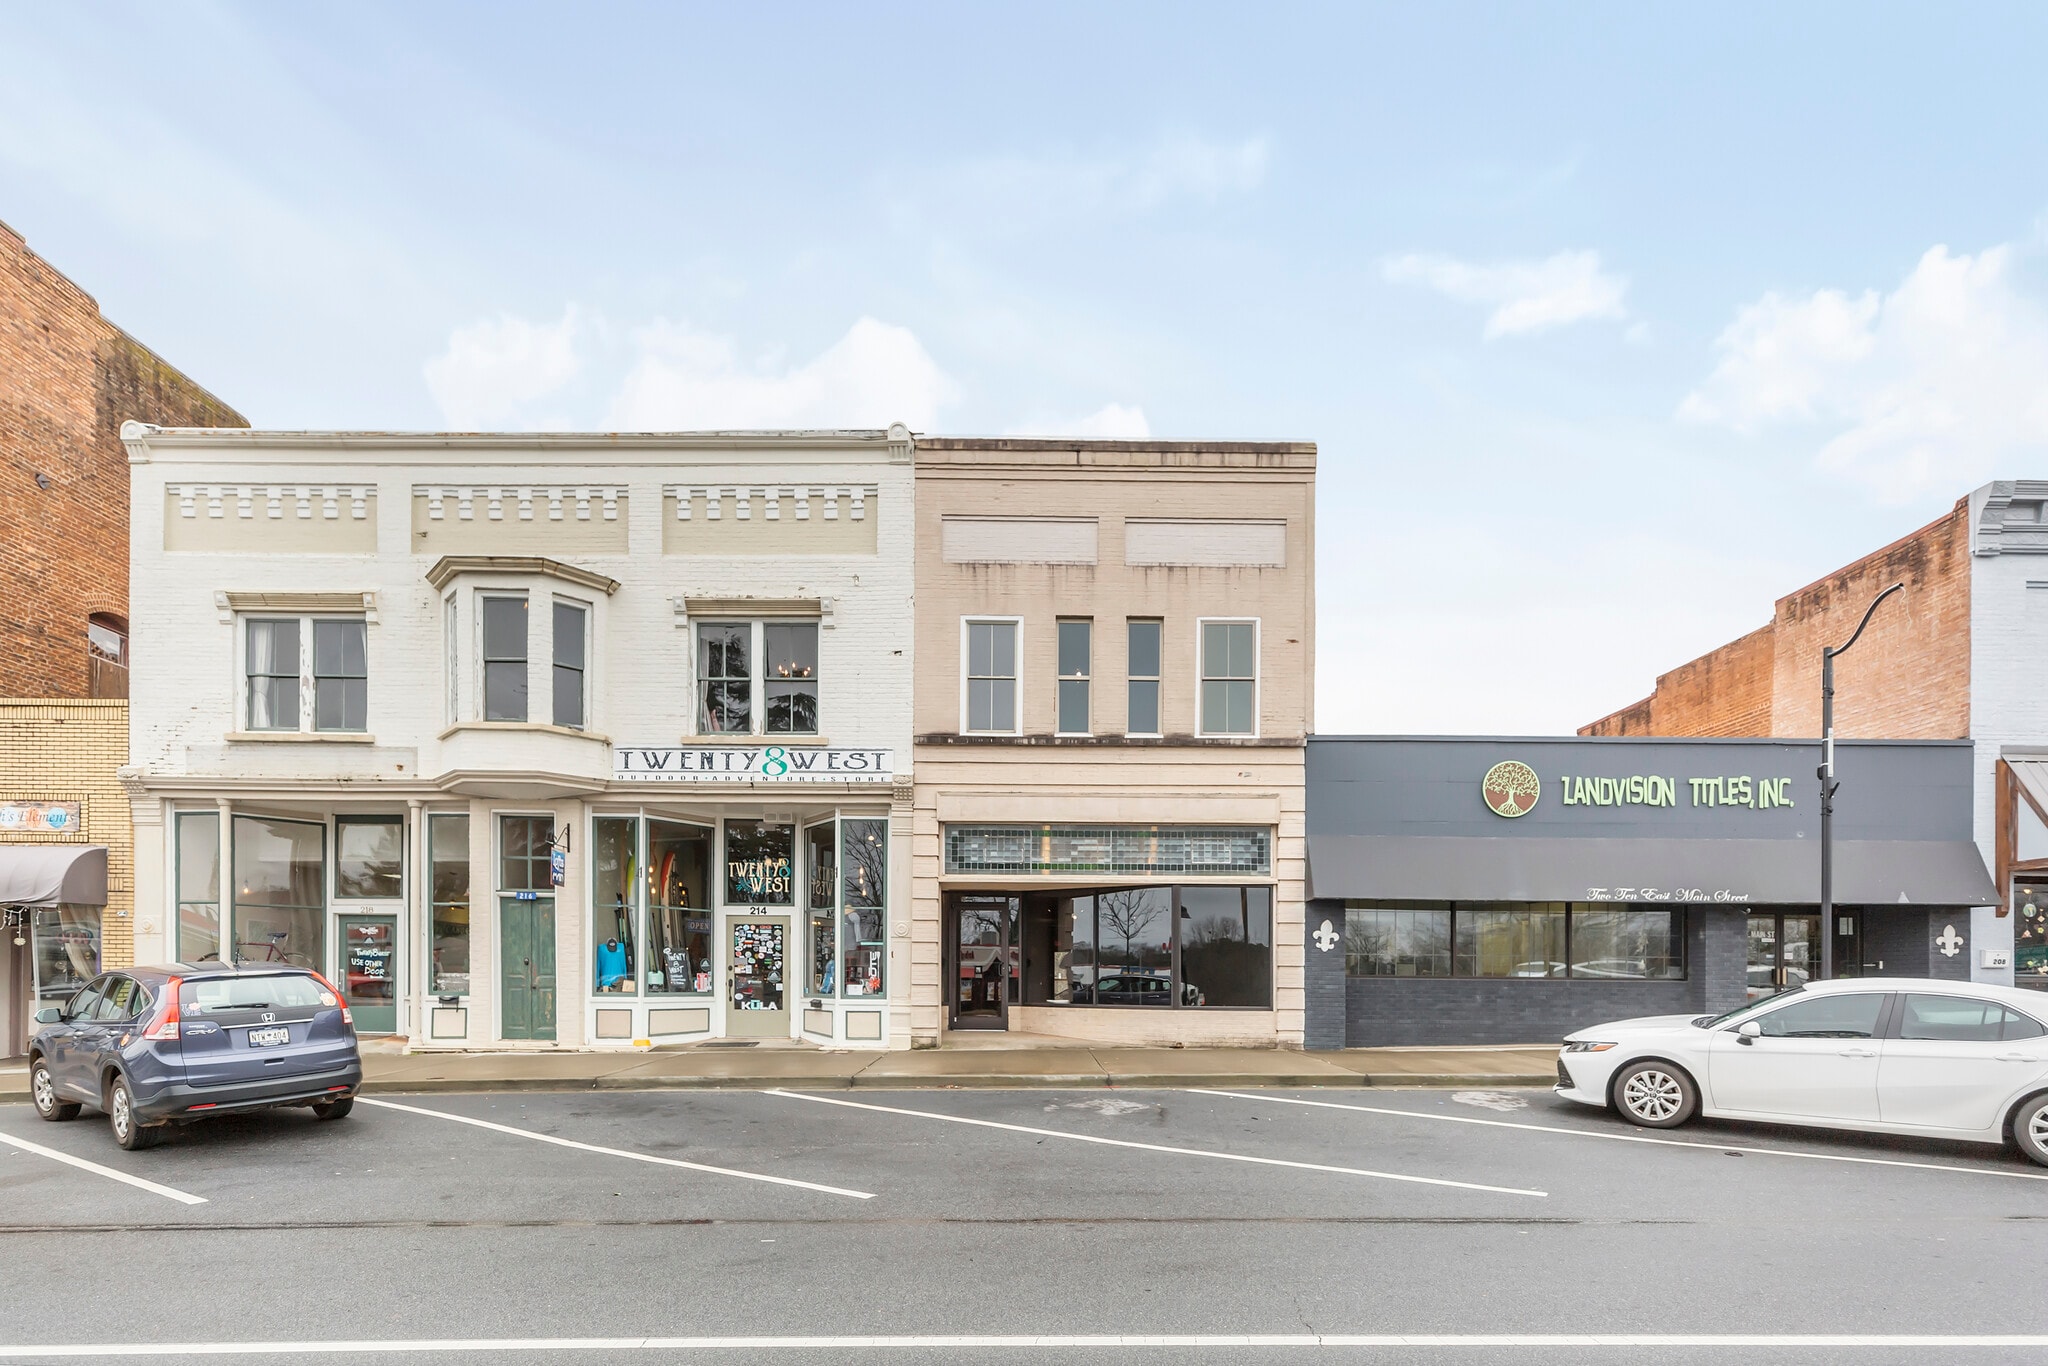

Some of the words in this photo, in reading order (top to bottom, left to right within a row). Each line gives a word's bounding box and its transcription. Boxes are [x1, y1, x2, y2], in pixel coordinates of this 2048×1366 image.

[619, 751, 759, 771] TWENTY
[788, 752, 885, 770] WEST
[1561, 775, 1676, 807] LANDVISION
[1758, 777, 1795, 809] INC.
[18, 810, 74, 823] Elements
[728, 862, 780, 877] TWENTY
[750, 877, 790, 892] WEST
[1586, 887, 1611, 901] Two
[1614, 887, 1637, 901] Ten
[1640, 888, 1671, 901] East
[1675, 888, 1711, 902] Main
[1714, 889, 1750, 902] Street
[360, 906, 374, 914] 218
[750, 907, 767, 915] 214
[1750, 930, 1766, 938] MAIN
[351, 958, 364, 967] USE
[364, 960, 384, 968] OTHER
[272, 1031, 287, 1040] 404
